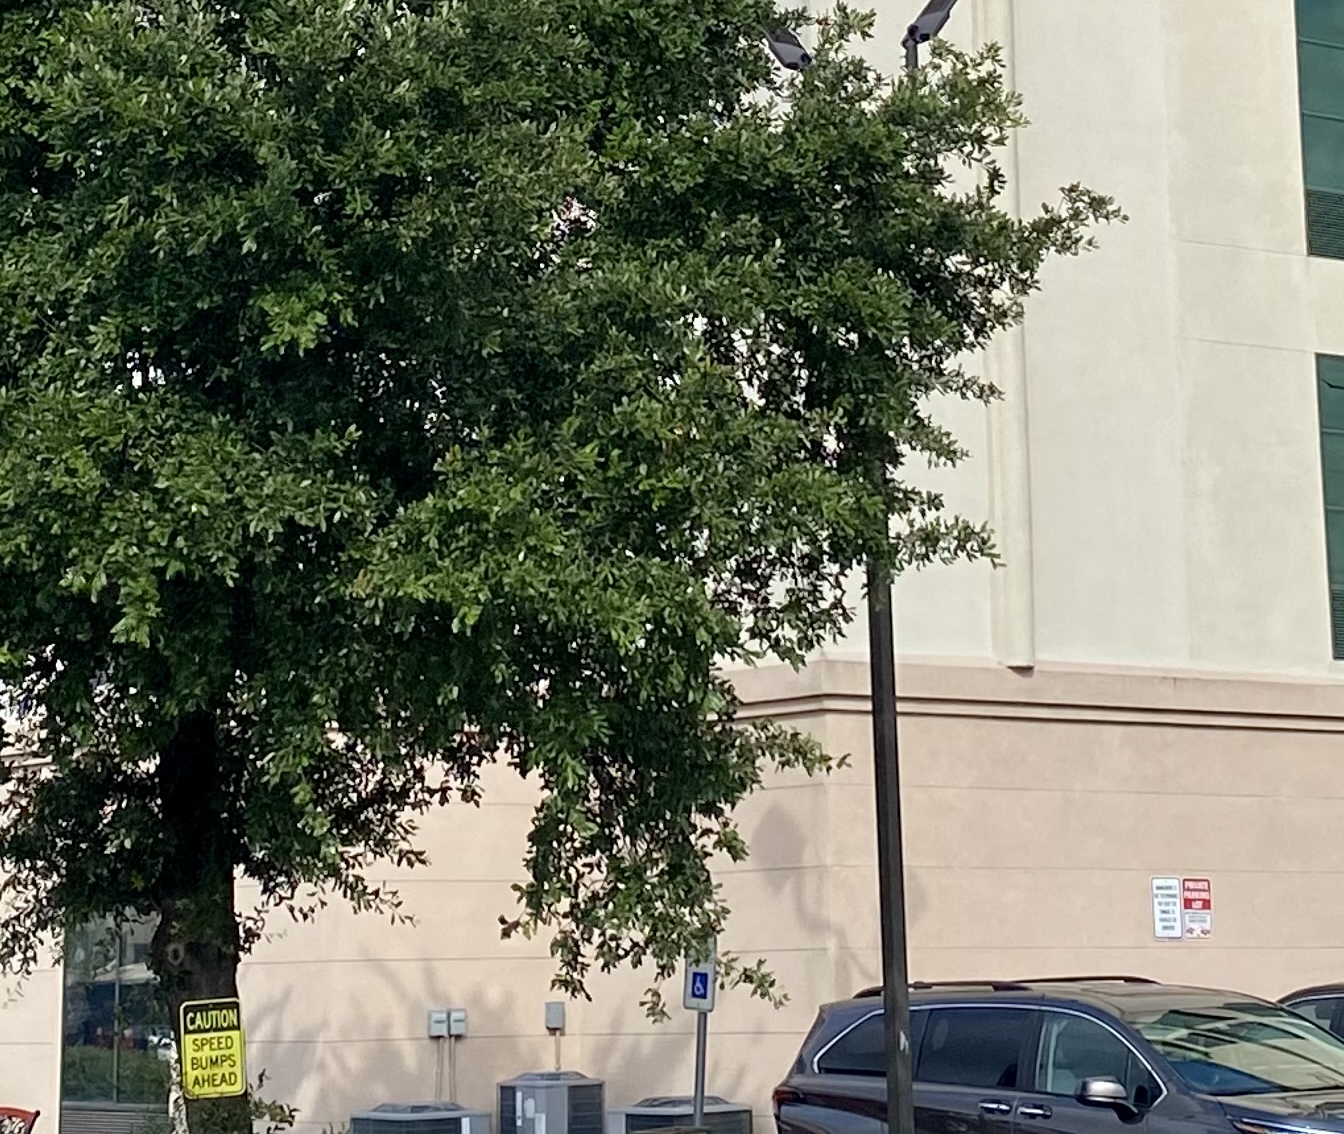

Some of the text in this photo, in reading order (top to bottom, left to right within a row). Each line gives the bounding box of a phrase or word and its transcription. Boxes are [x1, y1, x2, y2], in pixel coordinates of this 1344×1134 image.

[186, 1009, 238, 1030] CAUTION
[192, 1035, 234, 1053] SPEED
[191, 1053, 236, 1071] BUMPS
[191, 1071, 238, 1089] AHEAD
